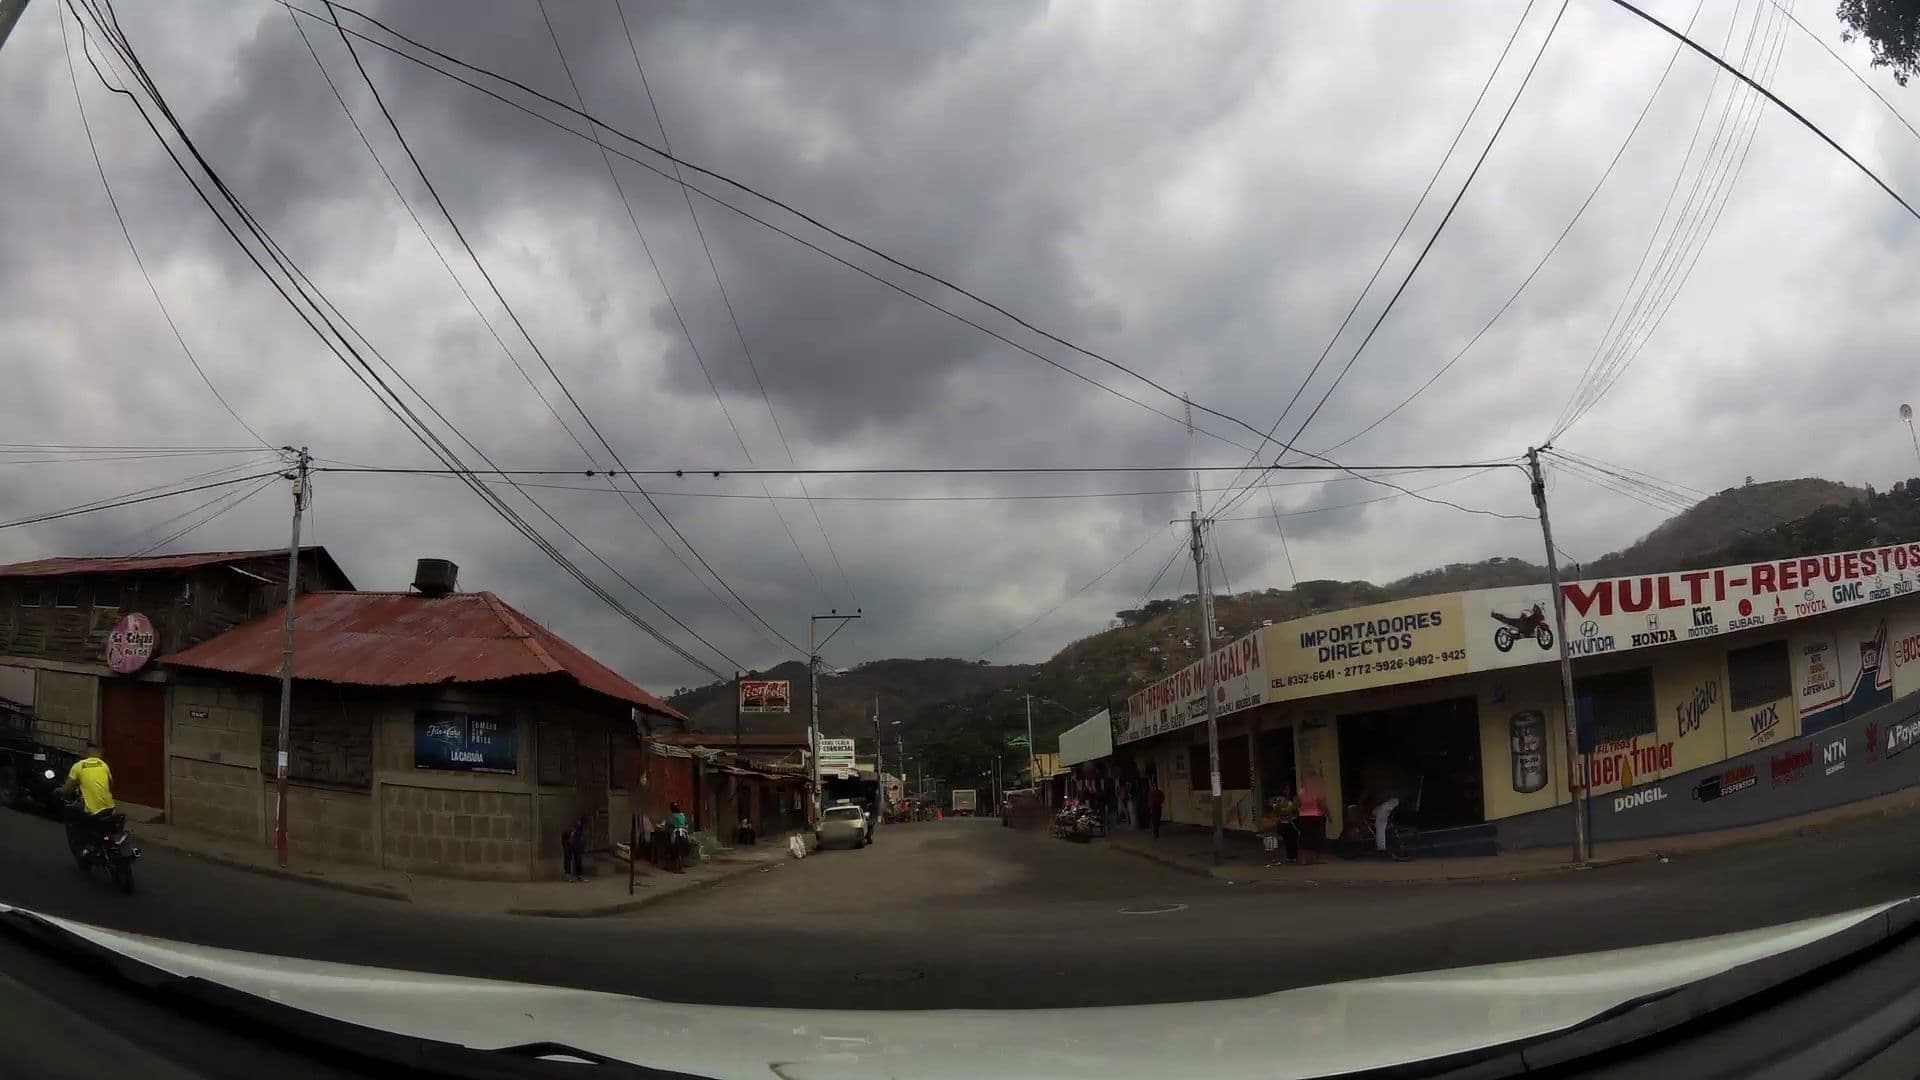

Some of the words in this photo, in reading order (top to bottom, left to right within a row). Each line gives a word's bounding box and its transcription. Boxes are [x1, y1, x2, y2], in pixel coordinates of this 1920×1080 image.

[1560, 544, 1920, 619] MULTI-REPUESTOS
[1832, 581, 1864, 604] GMC
[1893, 580, 1912, 595] ISUZU
[1795, 599, 1827, 616] TOYOTA
[1300, 611, 1442, 648] IMPORTADORES
[1688, 624, 1719, 639] MOTORS
[1729, 615, 1765, 630] SUBARU
[1319, 633, 1412, 663] DIRECTOS
[1567, 635, 1616, 657] HYUNDAI
[1631, 629, 1678, 647] HONDA
[1750, 703, 1779, 733] WIX
[1823, 738, 1847, 766] NTN
[1614, 786, 1668, 814] DONGIL
